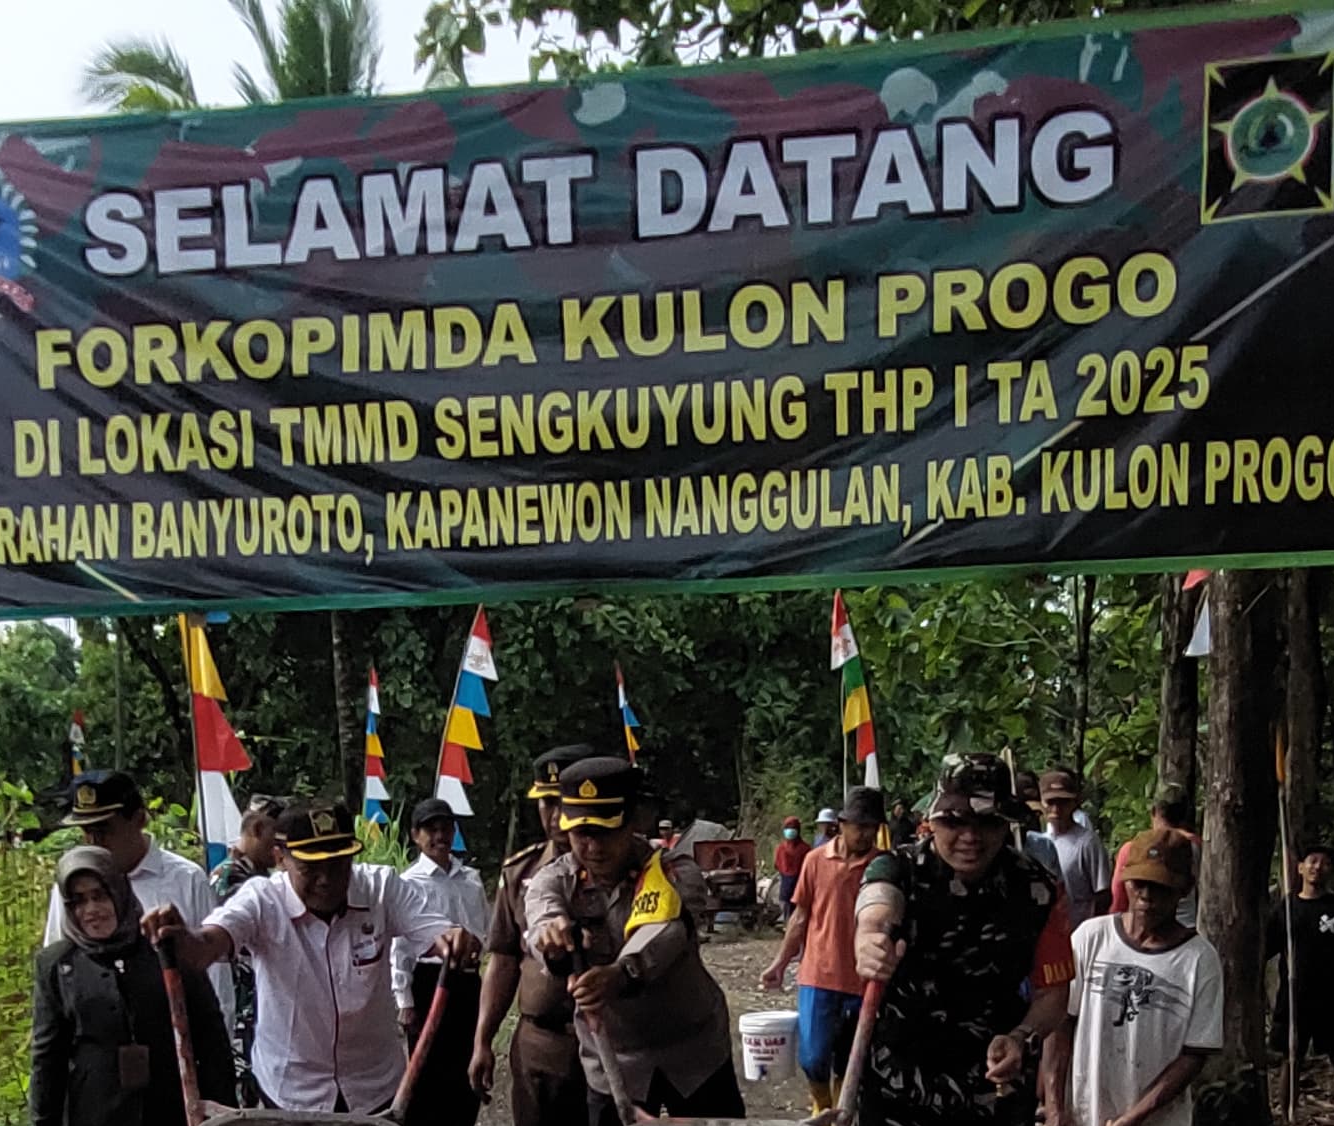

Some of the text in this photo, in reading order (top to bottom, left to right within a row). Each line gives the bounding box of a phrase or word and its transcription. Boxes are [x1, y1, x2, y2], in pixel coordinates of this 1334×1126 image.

[85, 112, 1113, 274] SELAMAT DATANG
[36, 252, 1176, 388] FORKOPIMDA KULON PROGO
[14, 344, 1211, 477] DI LOKASI TMMD SENGKUYUNG THP I TA 2025
[134, 495, 372, 566] BANYUROTO,
[386, 480, 626, 548] KAPANEWON
[645, 466, 910, 537] NANGGULAN,
[929, 457, 1026, 519] KAB.
[1041, 442, 1189, 513] KULON
